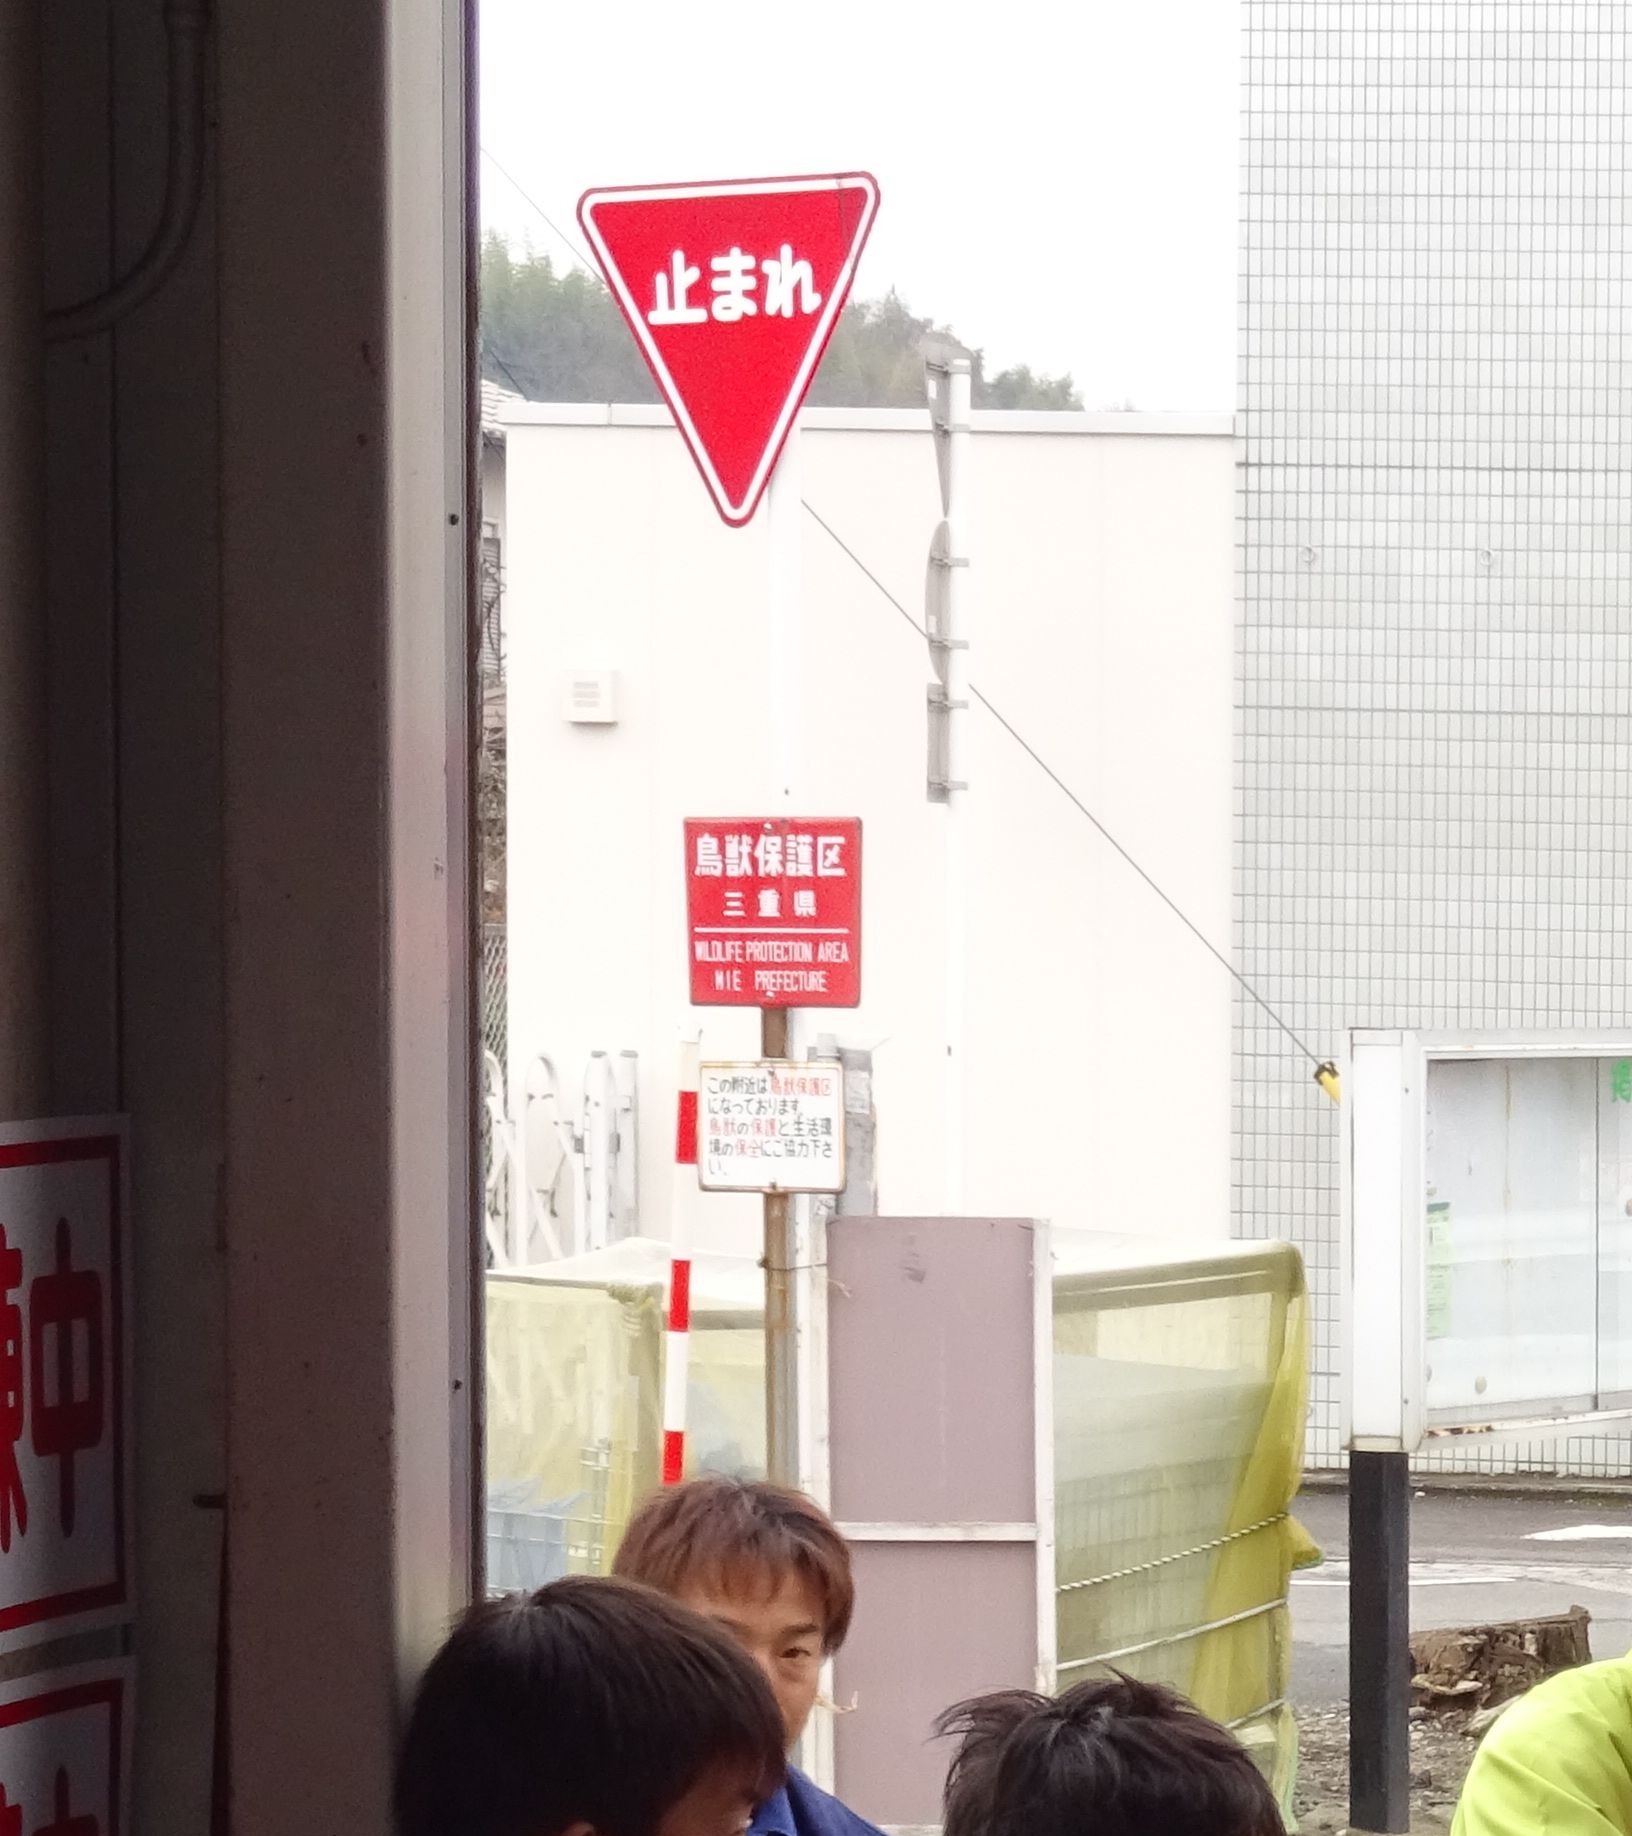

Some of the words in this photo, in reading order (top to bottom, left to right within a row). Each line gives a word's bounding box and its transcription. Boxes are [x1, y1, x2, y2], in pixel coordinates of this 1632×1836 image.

[648, 243, 822, 325] 止まれ
[694, 833, 848, 878] 鳥獣保護区
[722, 889, 817, 918] 三重県
[694, 941, 743, 962] WILDLIFE
[745, 941, 813, 963] PROTECTION
[817, 942, 850, 963] AREA
[714, 970, 742, 991] MIE
[754, 970, 828, 992] PREFECTURE
